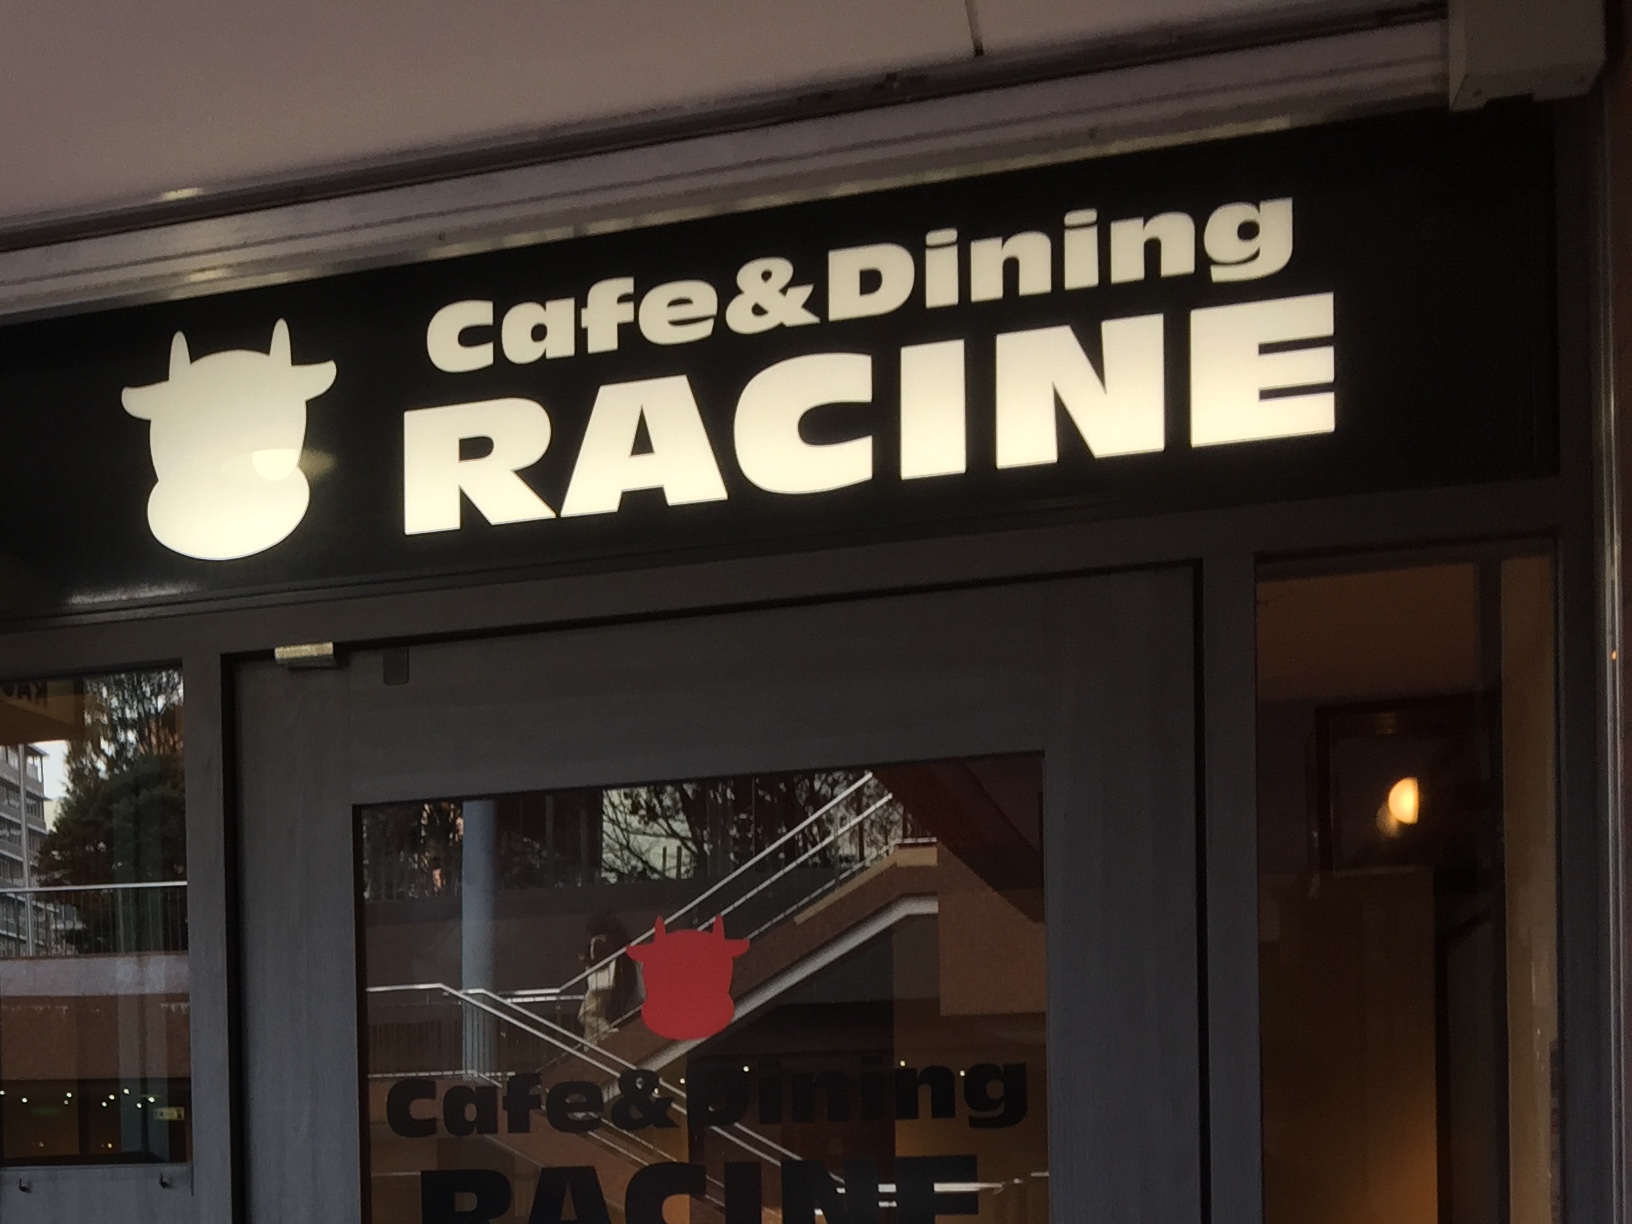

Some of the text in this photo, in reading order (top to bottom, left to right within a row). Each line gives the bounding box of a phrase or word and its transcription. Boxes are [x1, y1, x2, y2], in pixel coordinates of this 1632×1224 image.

[425, 197, 1295, 374] Cafe&Dining
[403, 291, 1337, 537] RACINE
[386, 1062, 1028, 1138] Cafe&Dining
